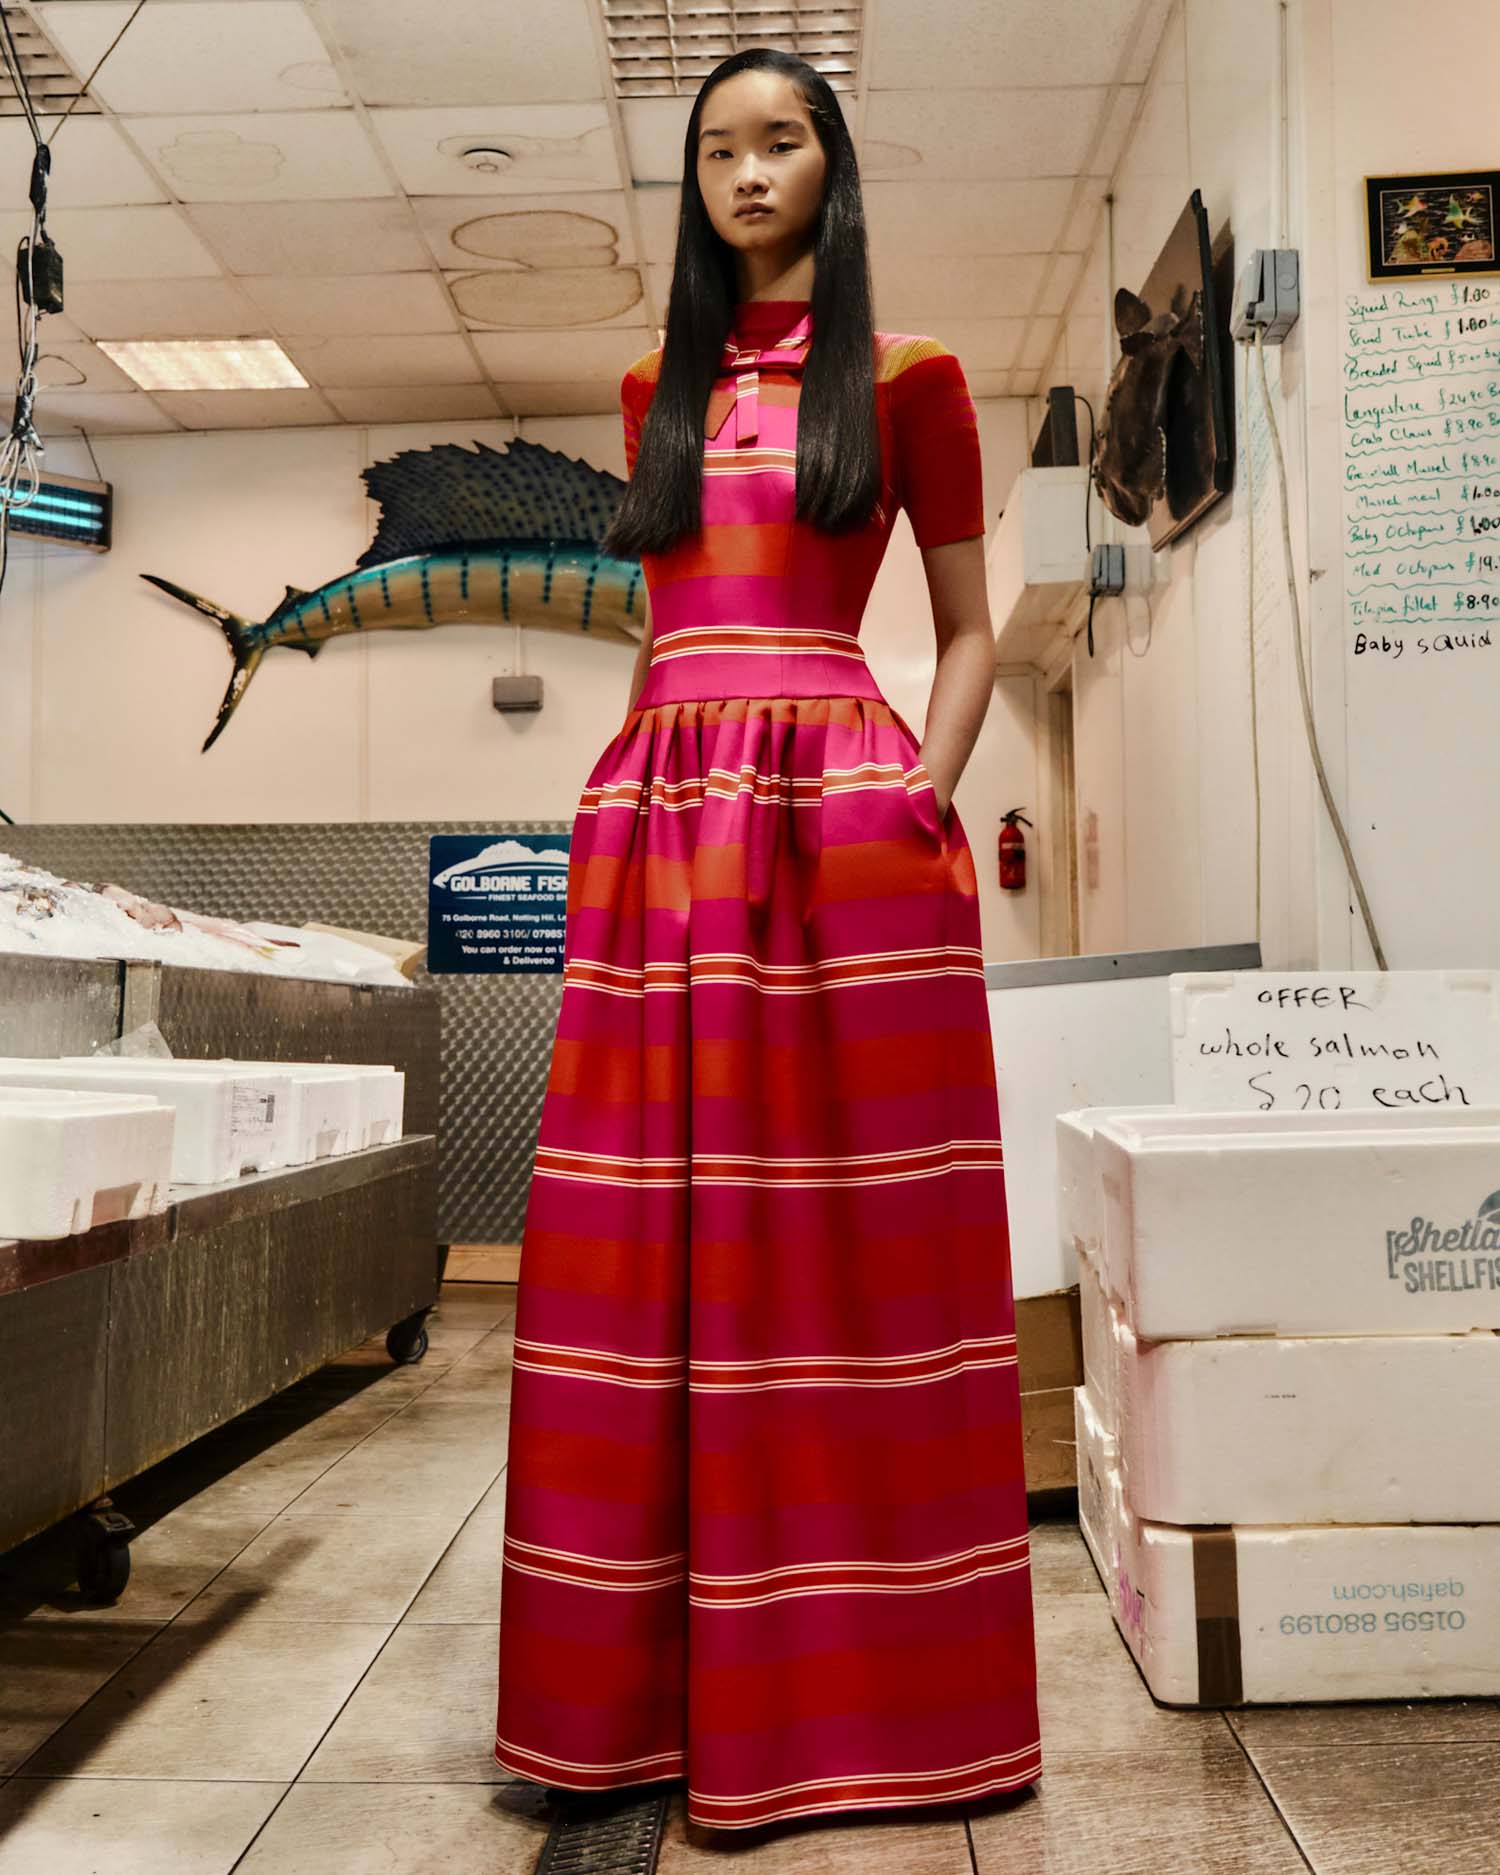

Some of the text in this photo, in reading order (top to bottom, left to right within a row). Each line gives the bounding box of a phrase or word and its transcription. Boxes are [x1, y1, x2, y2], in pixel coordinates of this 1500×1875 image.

[1352, 601, 1397, 616] Tilpia
[1354, 633, 1403, 659] Baby
[451, 876, 531, 892] GOLBORNE
[462, 945, 478, 954] You
[499, 945, 522, 954] order
[512, 956, 555, 965] Deliveroo
[1257, 986, 1374, 1011] OFFER
[1200, 1027, 1440, 1060] whole salmon
[1372, 1074, 1471, 1108] each
[1332, 1578, 1465, 1602] qafish.com
[1279, 1609, 1466, 1635] 01595 880199
